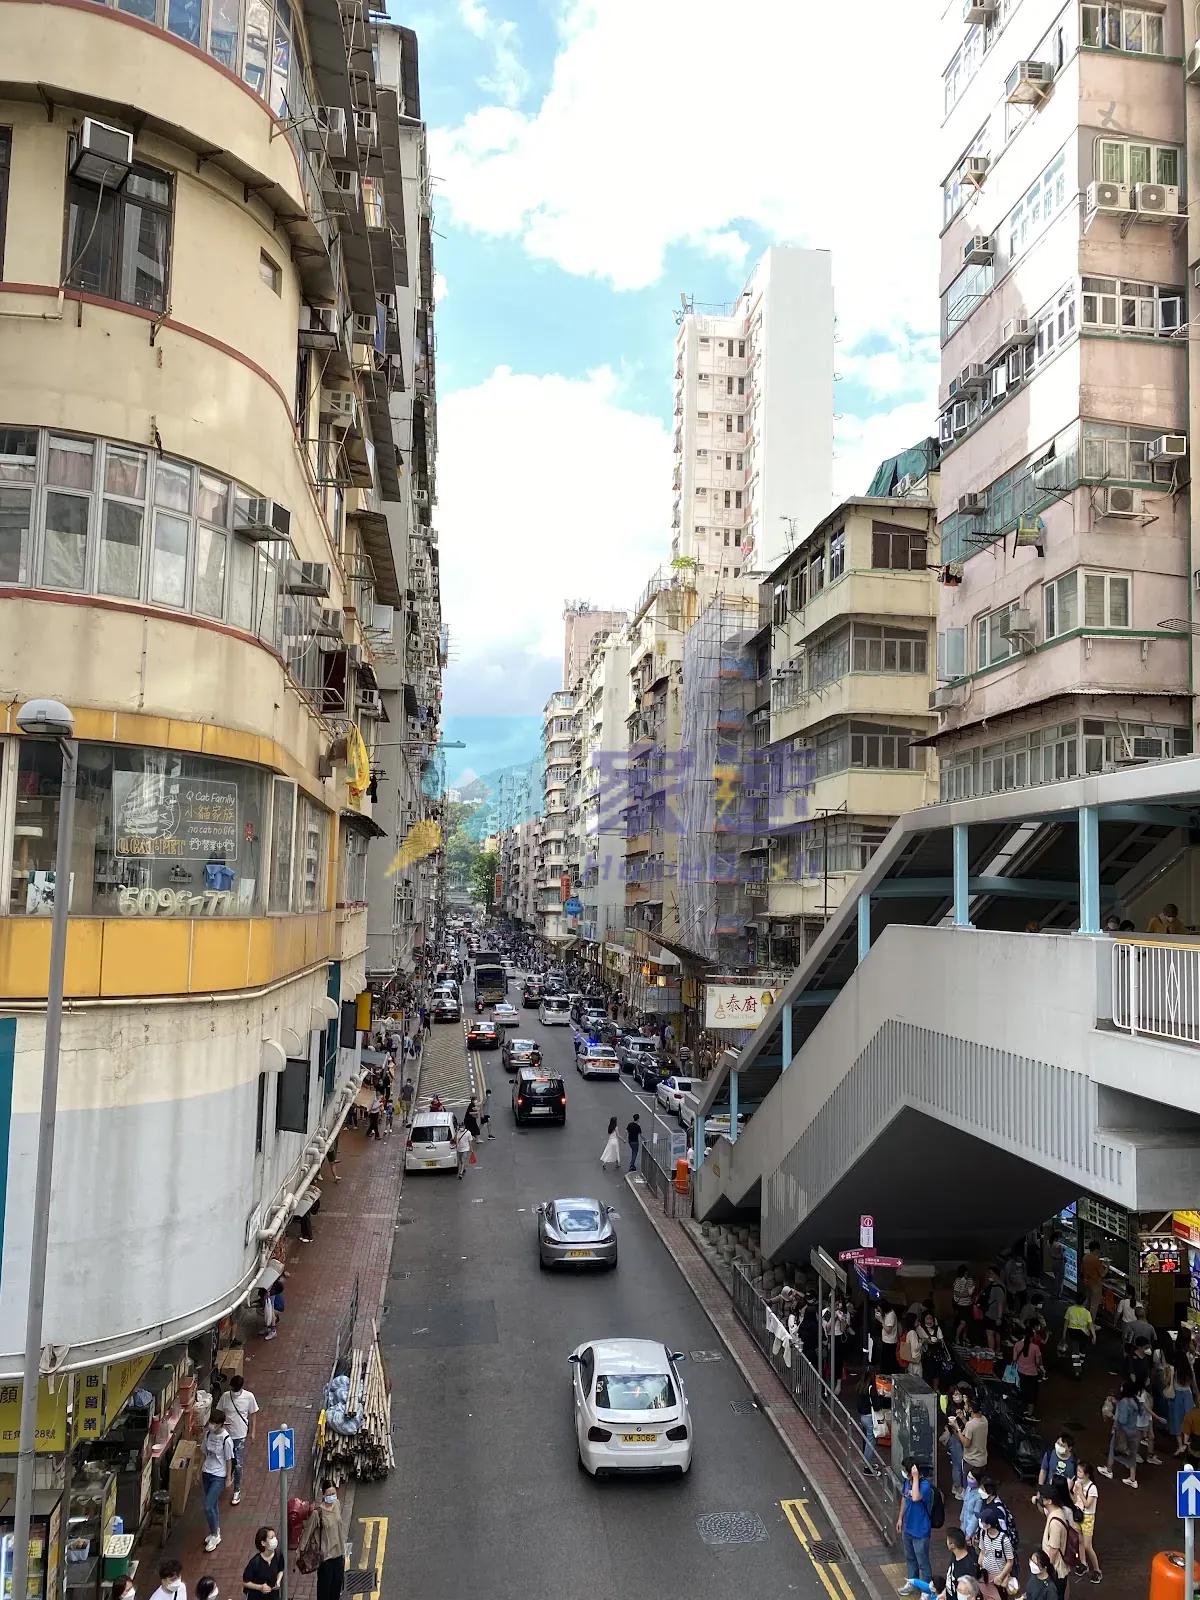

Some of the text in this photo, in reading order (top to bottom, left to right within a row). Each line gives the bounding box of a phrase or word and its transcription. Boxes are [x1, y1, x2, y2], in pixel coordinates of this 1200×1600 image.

[186, 790, 235, 806] Q Cat Family
[184, 804, 235, 821] 小貓家族
[187, 825, 235, 836] no cat no life
[201, 838, 223, 851] 營業中
[726, 993, 758, 1013] 泰廚
